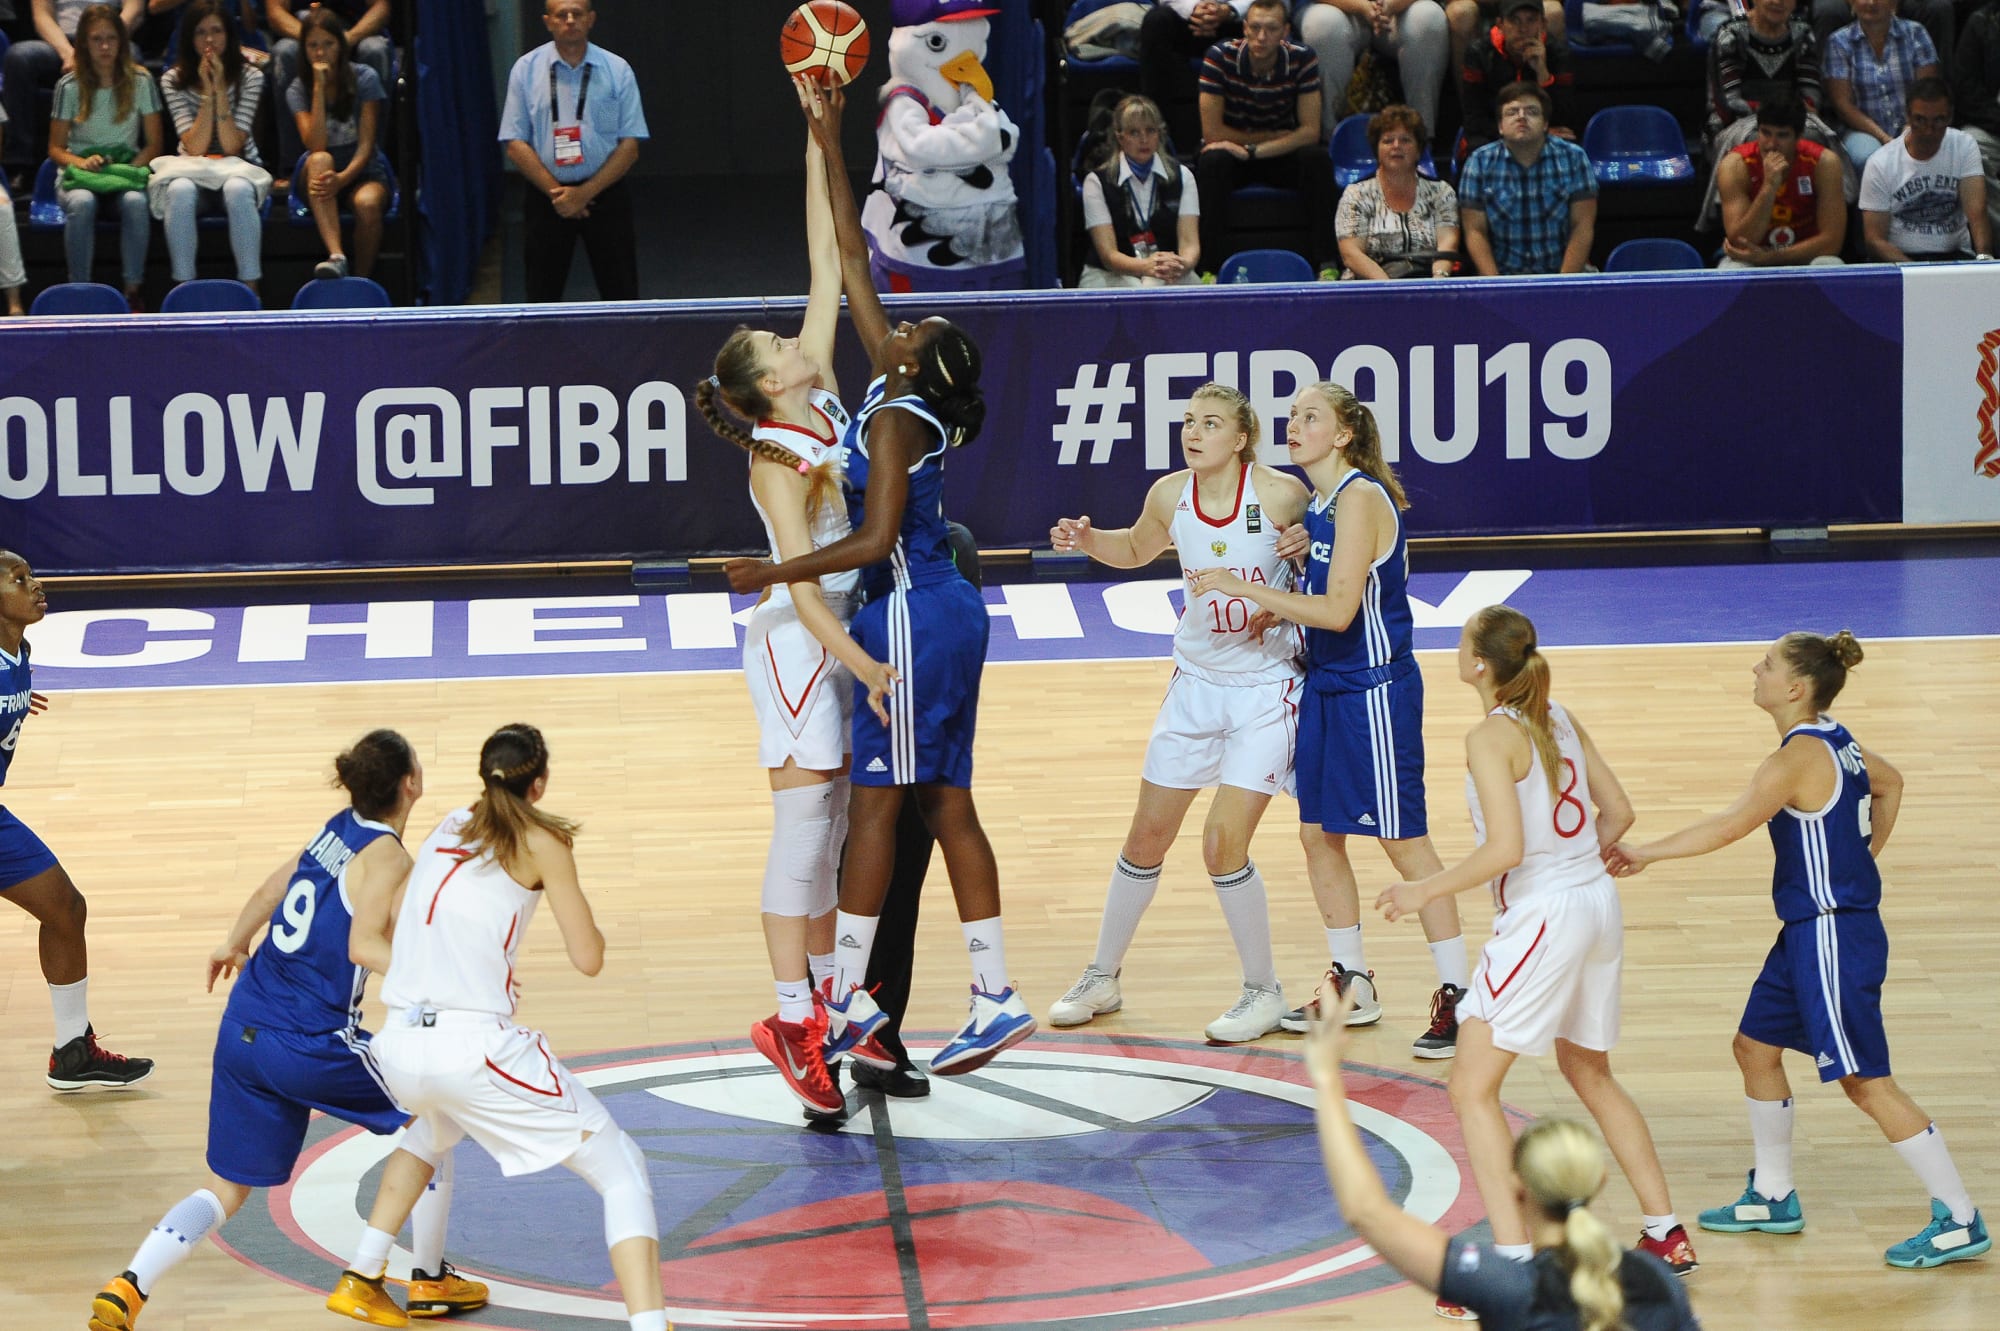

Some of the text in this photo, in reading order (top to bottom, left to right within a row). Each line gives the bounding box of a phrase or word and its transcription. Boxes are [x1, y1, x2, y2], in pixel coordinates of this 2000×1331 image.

[1893, 175, 1931, 202] WEST
[0, 381, 687, 505] OLLOW @FIBA
[1208, 598, 1248, 633] 10
[1553, 757, 1586, 838] 8
[272, 879, 316, 953] 9
[426, 847, 474, 925] 7
